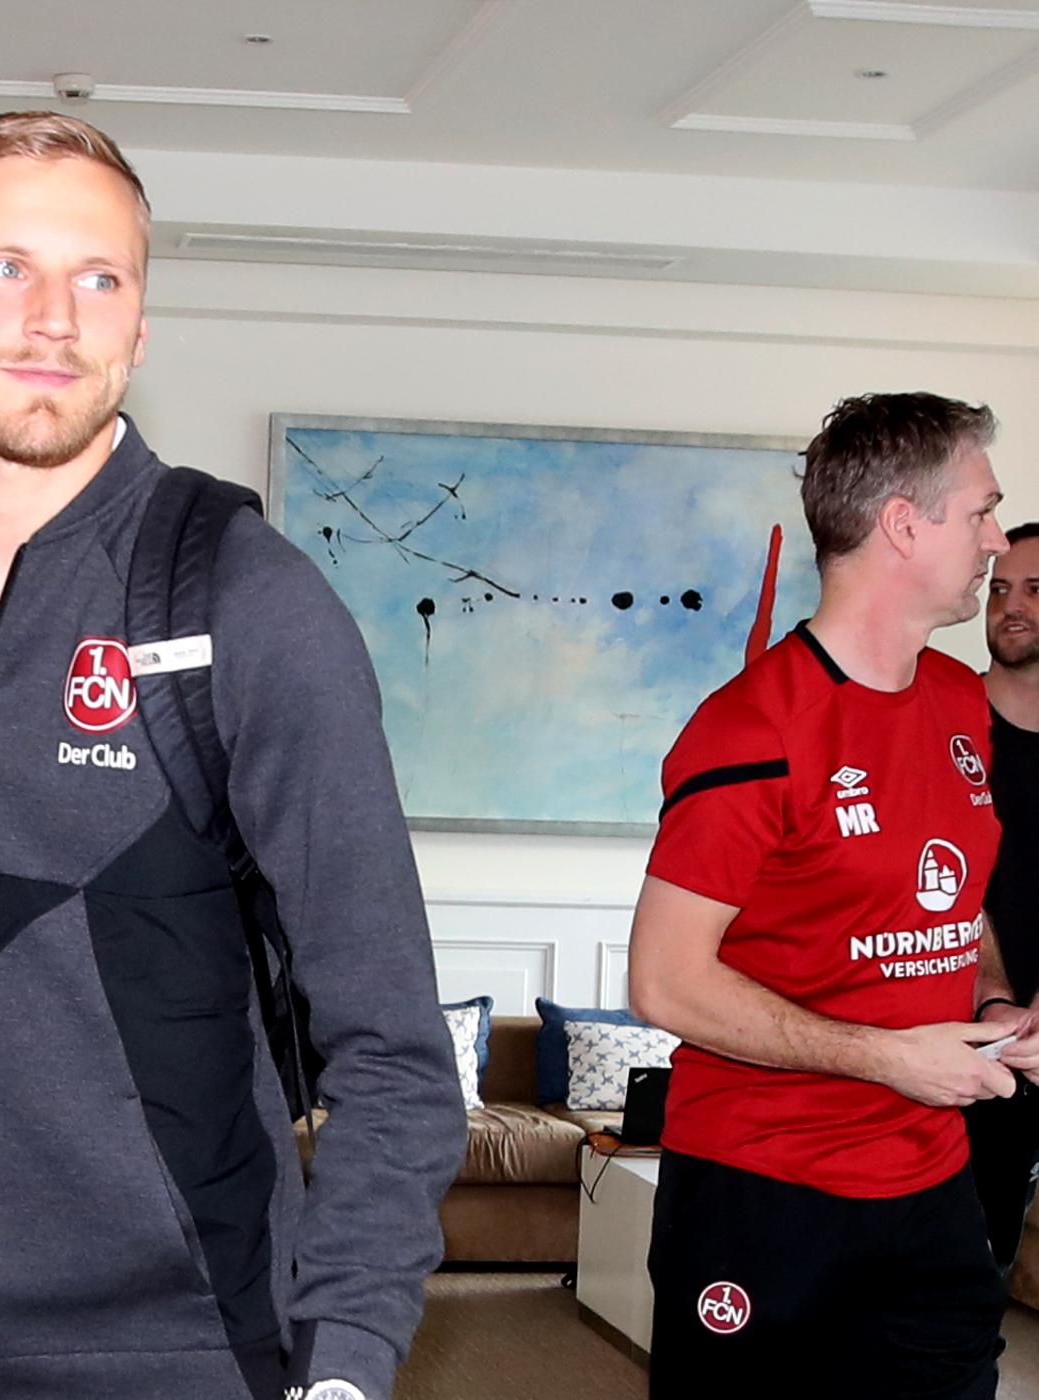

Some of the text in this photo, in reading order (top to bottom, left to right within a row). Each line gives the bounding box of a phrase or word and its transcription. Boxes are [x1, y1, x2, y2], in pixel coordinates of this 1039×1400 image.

[88, 646, 109, 676] 1.
[68, 675, 131, 710] FCN
[57, 741, 137, 771] Der Club
[835, 802, 881, 838] MR
[850, 912, 984, 961] NÜRNBERGE
[702, 1298, 743, 1326] FCN
